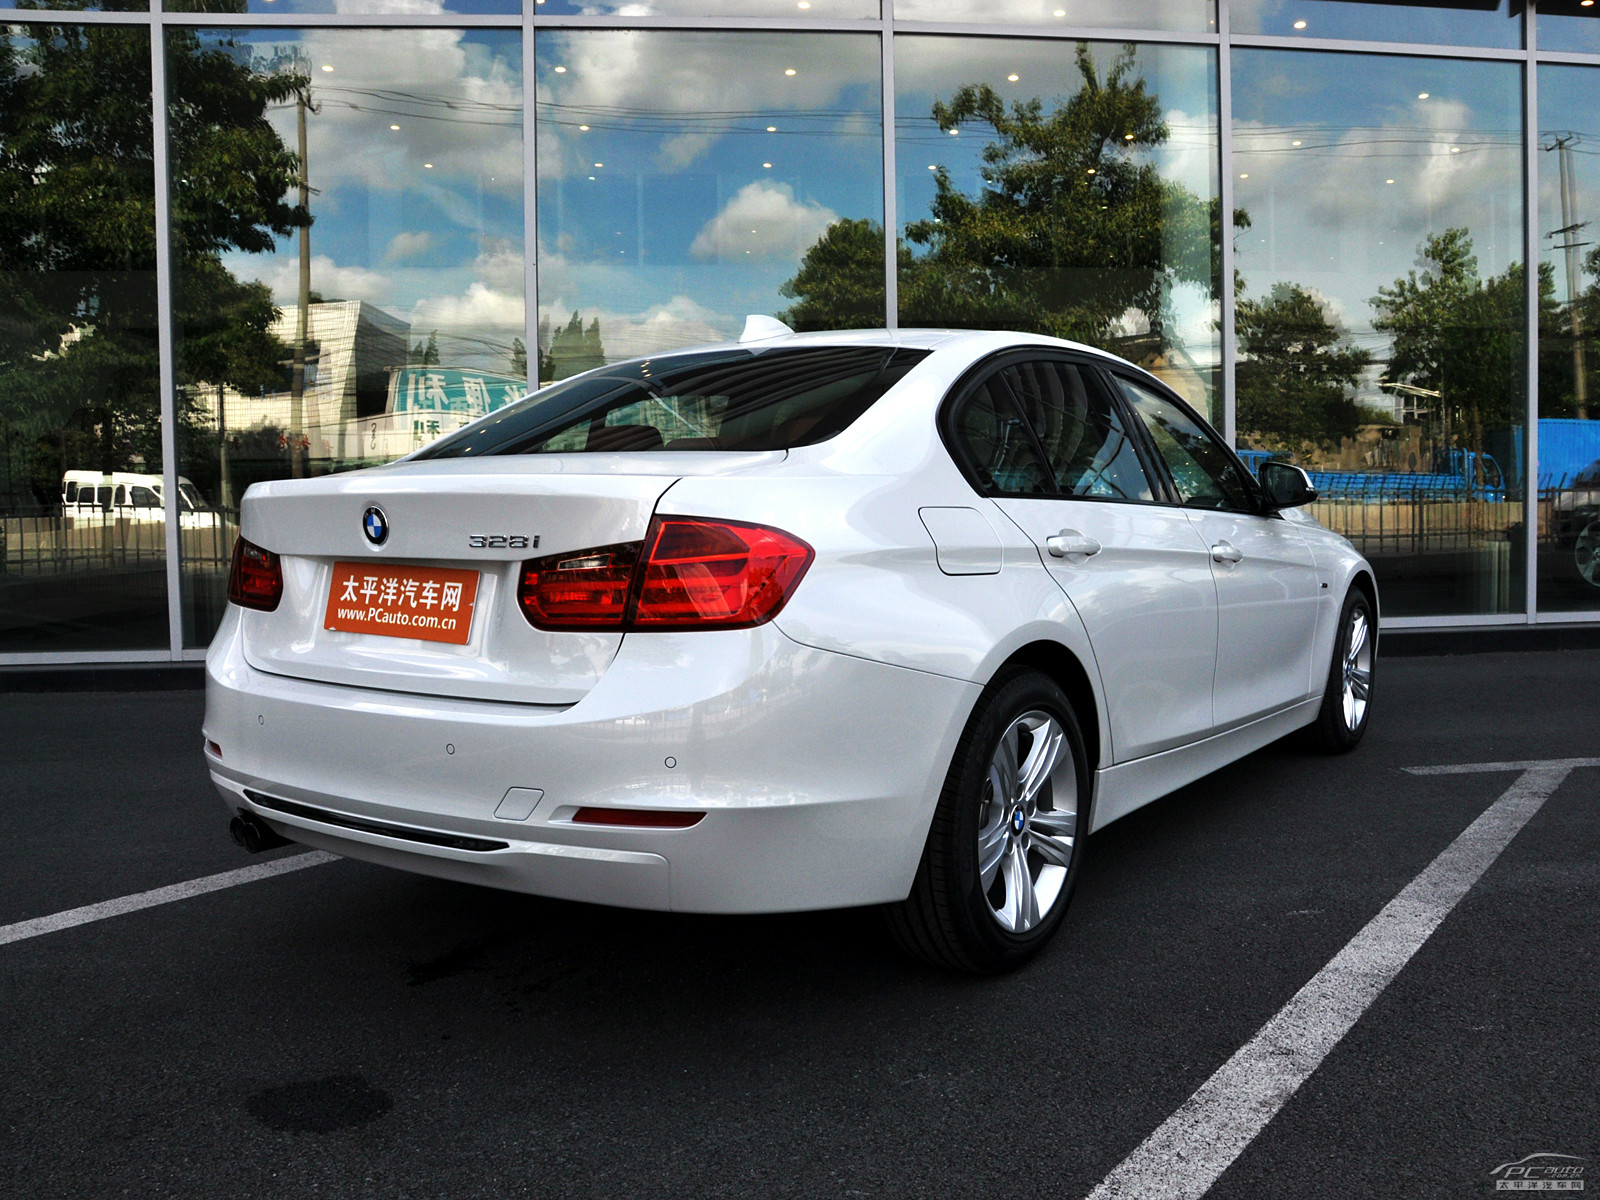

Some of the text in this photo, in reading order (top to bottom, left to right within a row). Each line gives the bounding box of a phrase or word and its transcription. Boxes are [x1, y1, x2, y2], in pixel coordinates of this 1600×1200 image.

[469, 534, 541, 549] 328i
[340, 575, 462, 612] 太平洋汽车网
[337, 607, 457, 630] www.PCauto.com.cn
